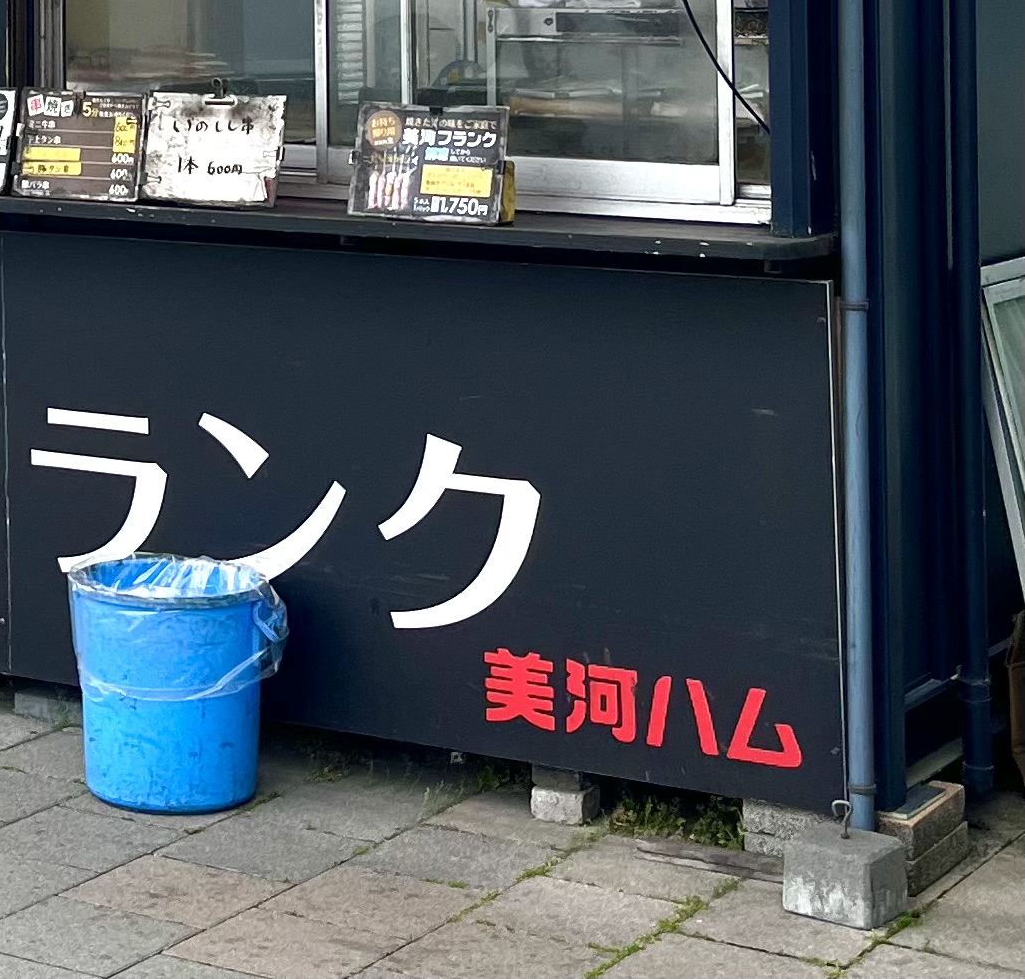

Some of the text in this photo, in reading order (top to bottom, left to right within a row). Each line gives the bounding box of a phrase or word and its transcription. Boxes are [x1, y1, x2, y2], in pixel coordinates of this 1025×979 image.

[173, 116, 255, 135] いのしし串
[401, 127, 497, 148] 美河フランク
[207, 161, 243, 175] 600円
[484, 648, 803, 769] 美河ハム
